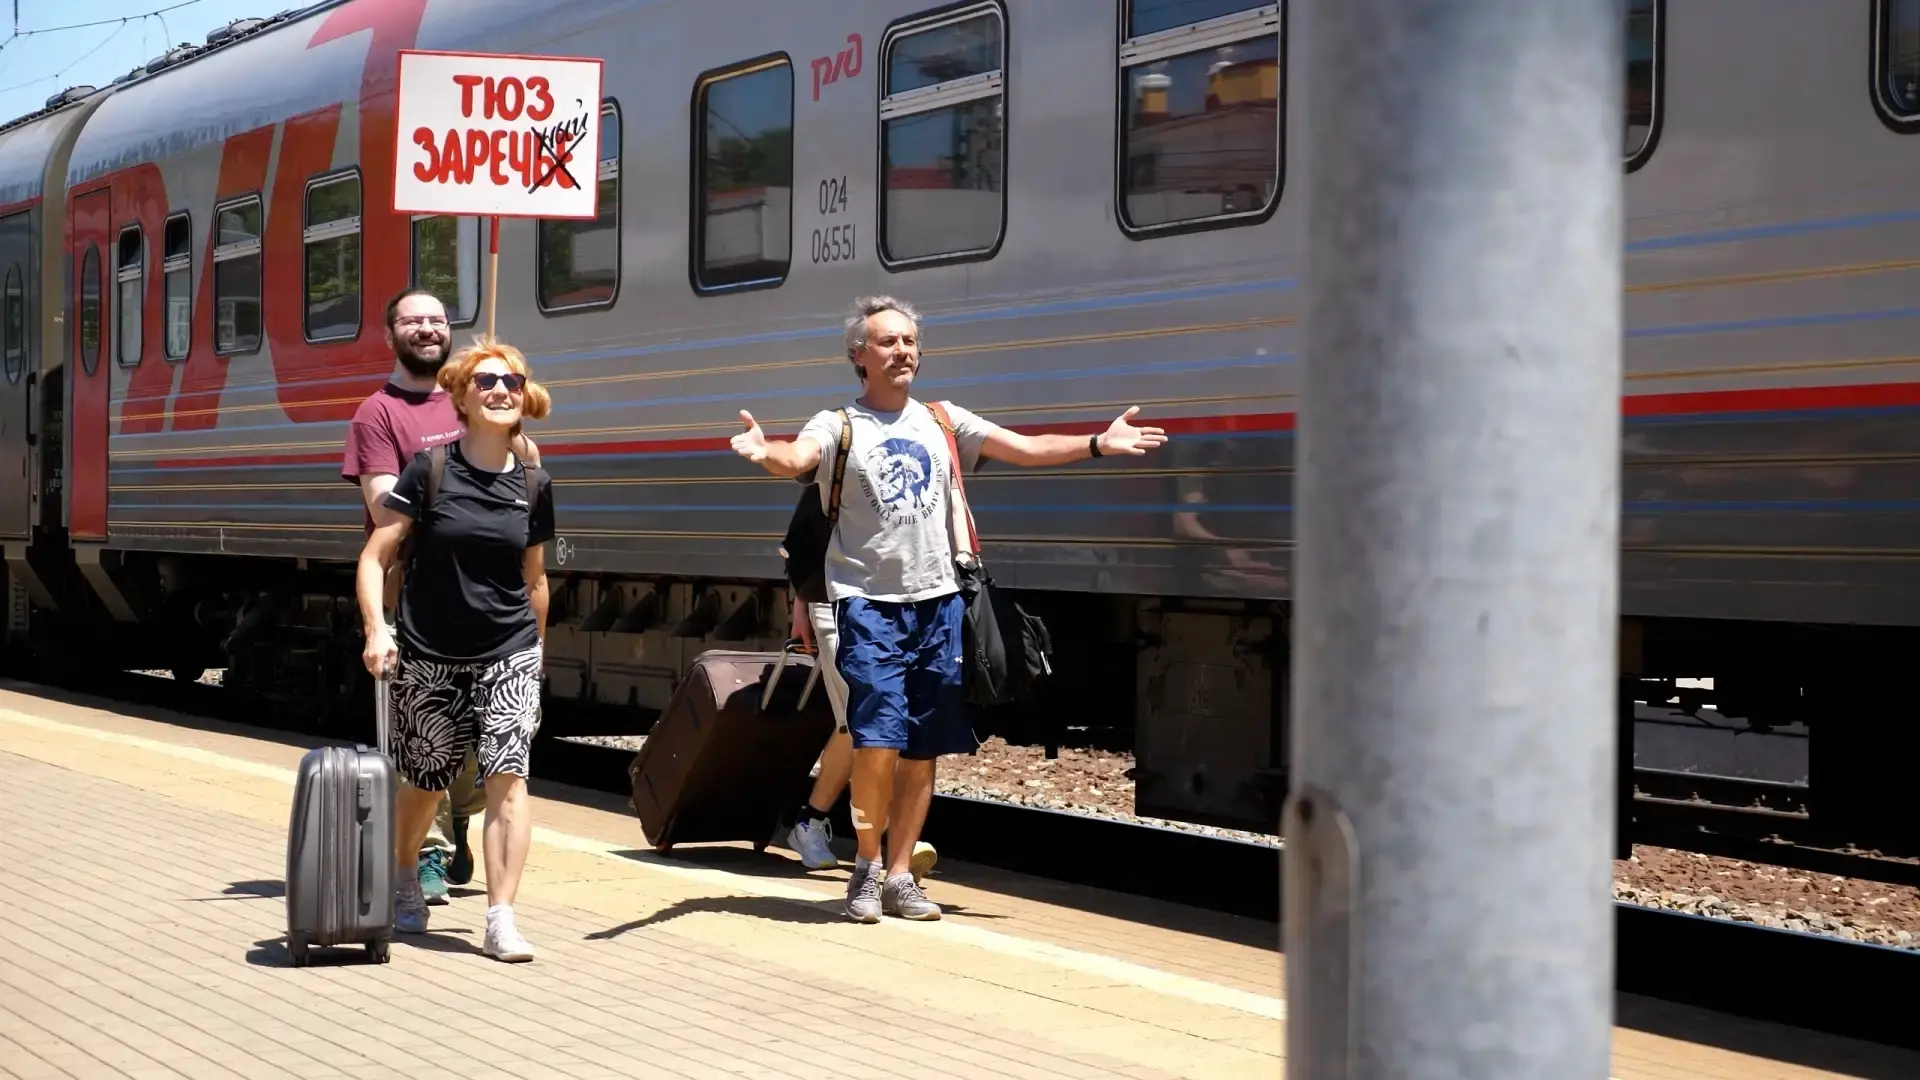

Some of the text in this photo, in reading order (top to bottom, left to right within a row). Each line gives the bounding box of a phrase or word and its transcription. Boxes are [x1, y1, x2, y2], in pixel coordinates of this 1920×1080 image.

[453, 75, 554, 121] ТЮЗ
[819, 175, 848, 214] 024
[812, 224, 856, 263] 06551
[870, 499, 893, 521] ONLY
[898, 515, 918, 525] THE
